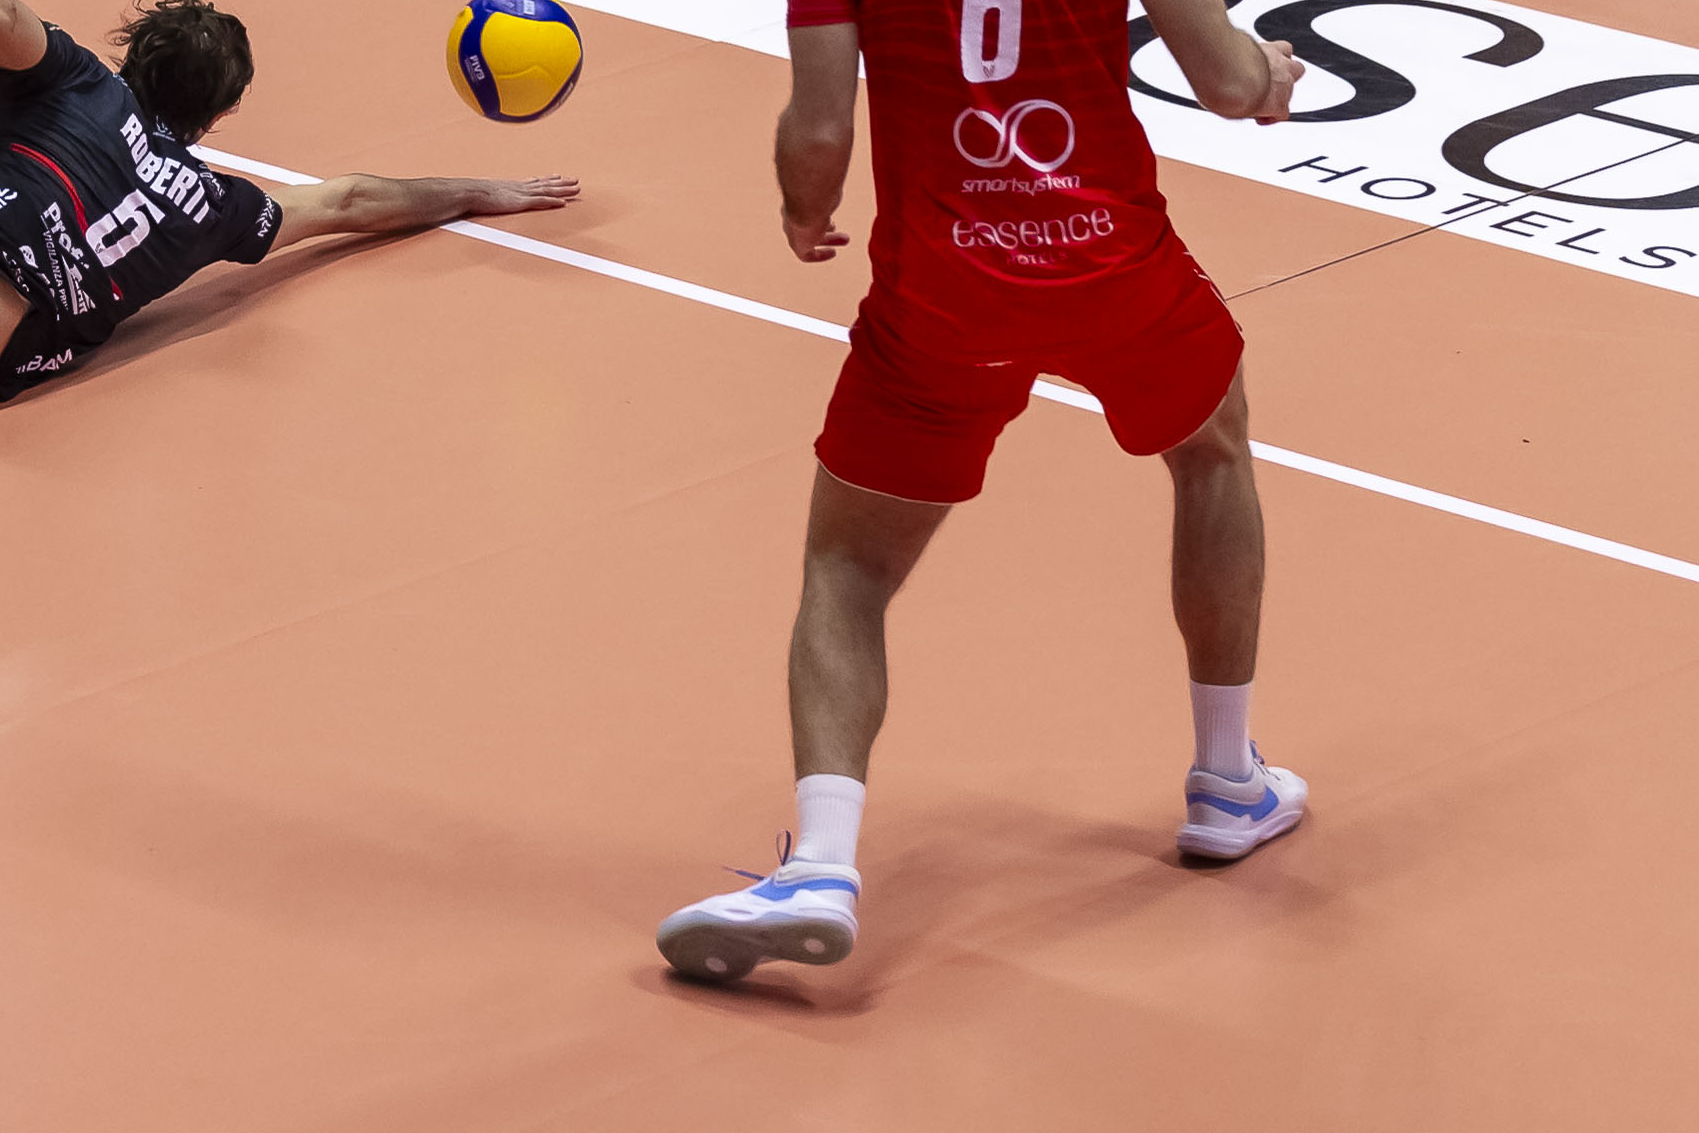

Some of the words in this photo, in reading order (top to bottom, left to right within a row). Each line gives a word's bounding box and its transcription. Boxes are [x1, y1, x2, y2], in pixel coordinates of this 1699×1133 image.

[961, 173, 1081, 197] smartsystem
[1275, 154, 1698, 270] HOTELS
[85, 188, 167, 268] 5
[952, 207, 1115, 250] essence
